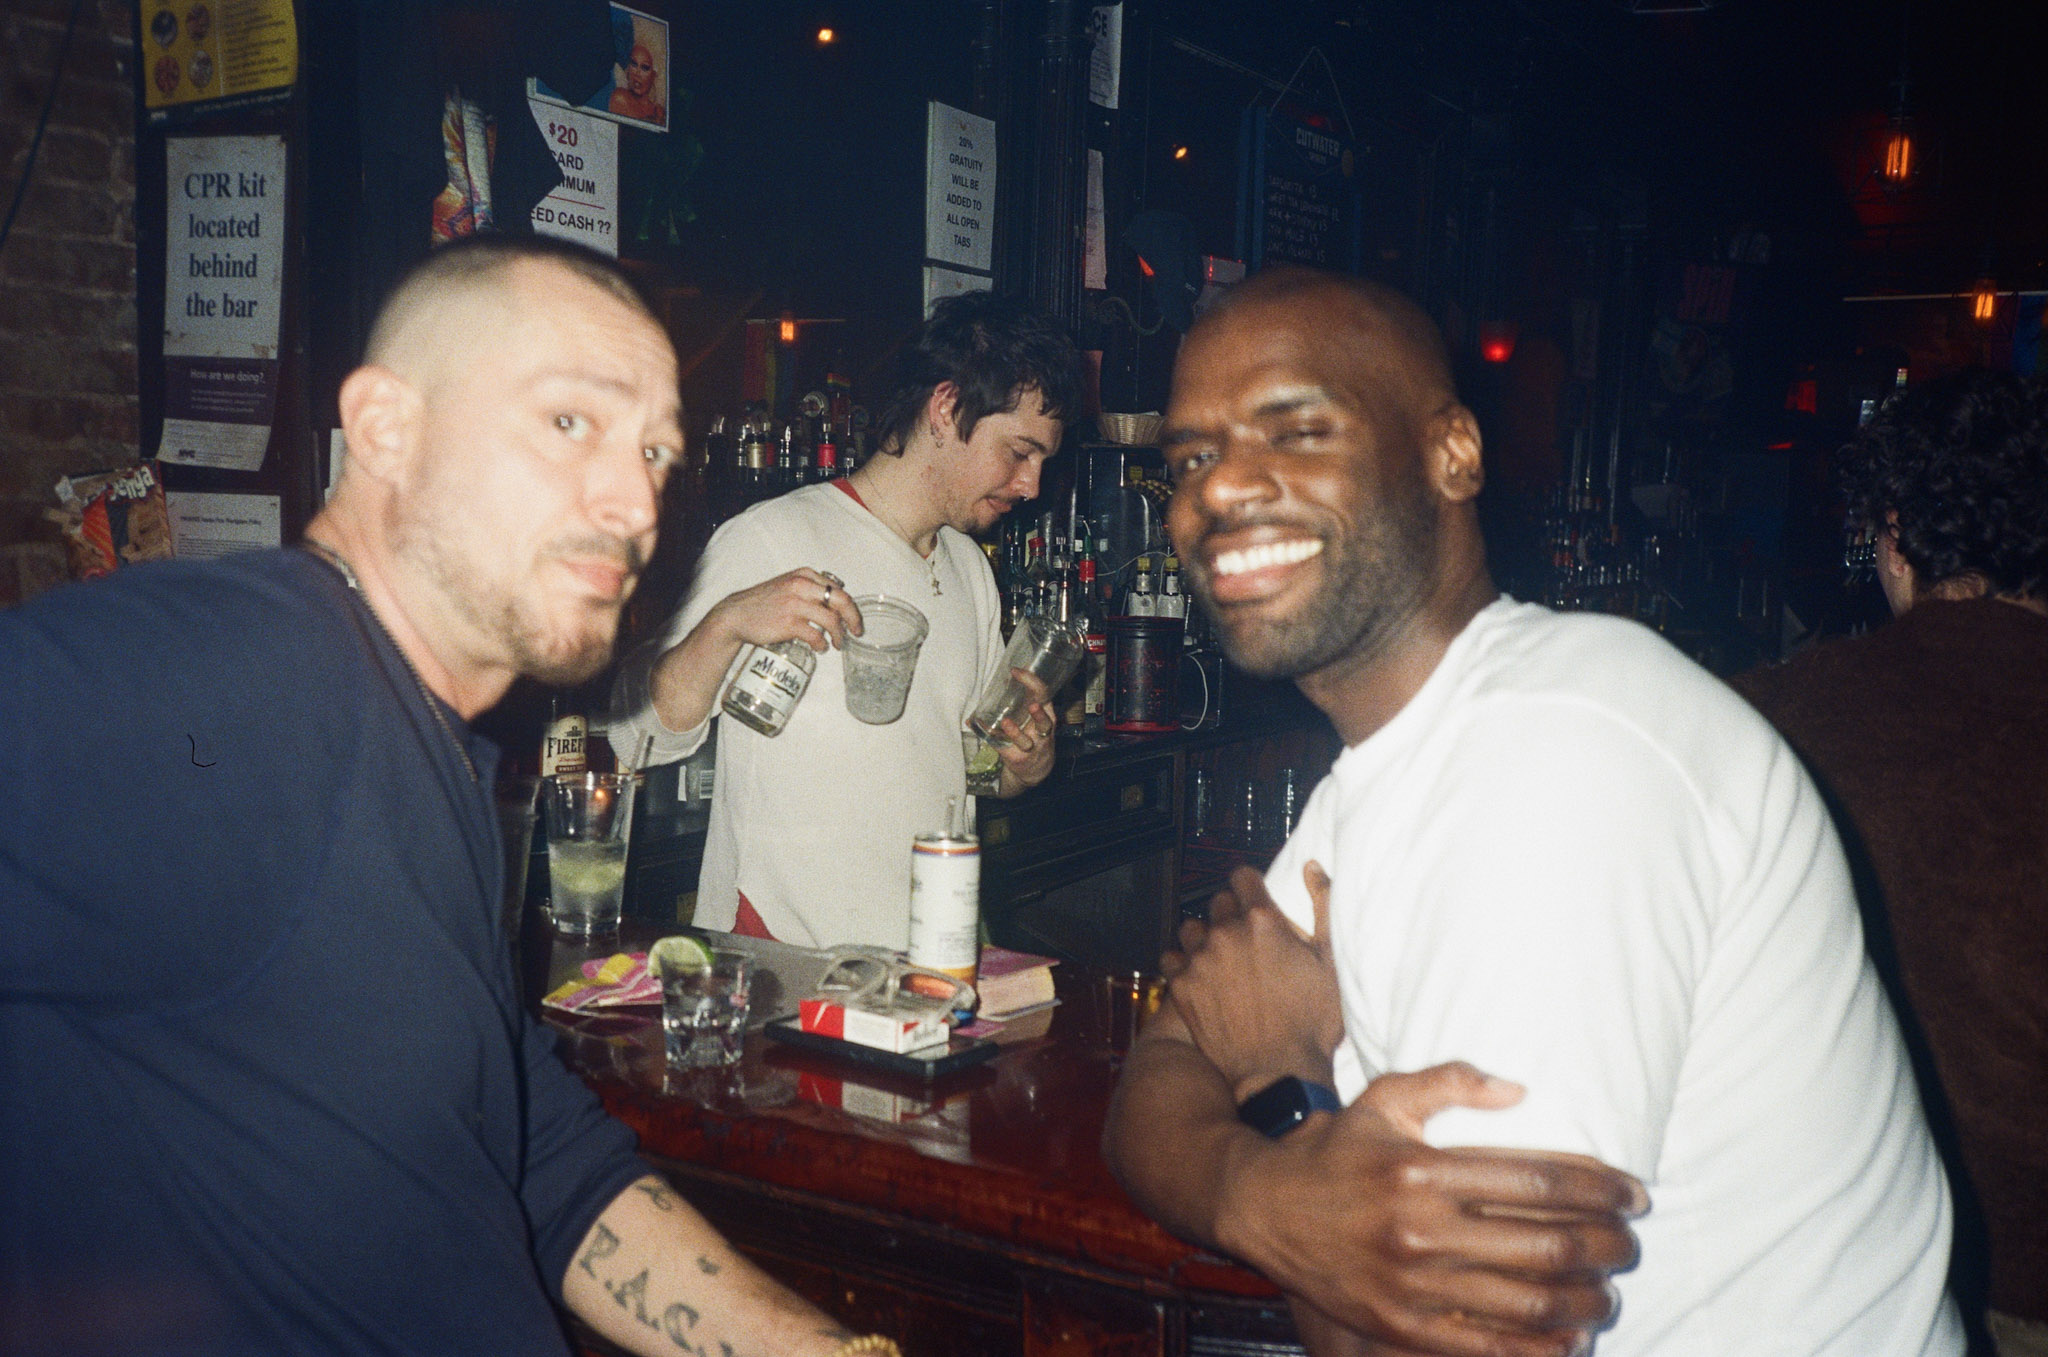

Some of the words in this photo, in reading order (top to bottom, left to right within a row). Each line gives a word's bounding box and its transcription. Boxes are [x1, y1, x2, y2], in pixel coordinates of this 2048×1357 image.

[548, 122, 578, 147] $20
[958, 135, 974, 150] 20%
[1296, 127, 1341, 157] CUTWATER
[949, 152, 983, 172] GRATUITY
[184, 172, 232, 199] CPR
[238, 172, 267, 198] kit
[951, 173, 969, 188] WILL
[969, 178, 980, 190] BE
[946, 193, 972, 208] ADDED
[972, 199, 983, 211] TO
[188, 213, 260, 238] located
[558, 211, 594, 232] CASH
[597, 220, 612, 235] ??
[946, 213, 960, 226] ALL
[960, 216, 980, 230] OPEN
[953, 234, 972, 248] TABS
[189, 252, 258, 278] behind
[185, 292, 217, 317] the
[222, 293, 258, 318] bar
[190, 369, 207, 379] How
[209, 371, 222, 381] are
[223, 372, 236, 381] we
[236, 371, 267, 385] doing?
[750, 655, 801, 692] Modelo
